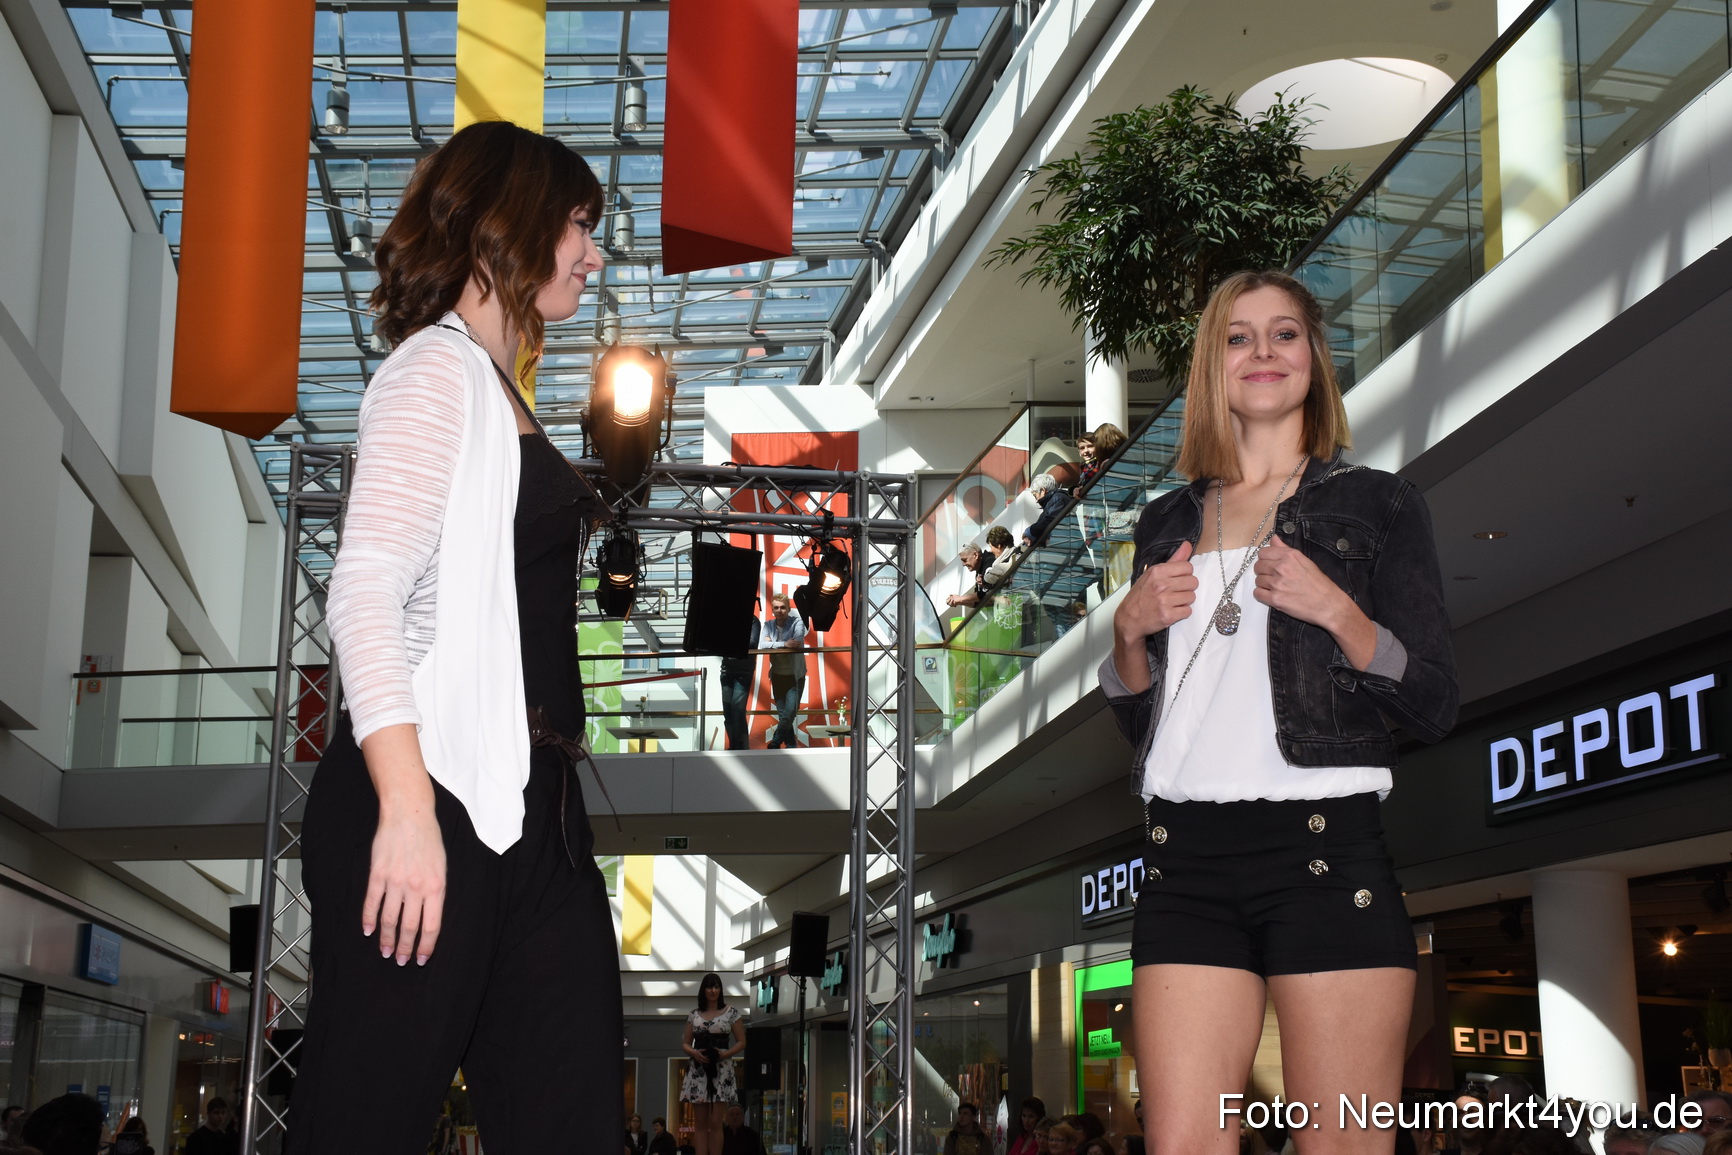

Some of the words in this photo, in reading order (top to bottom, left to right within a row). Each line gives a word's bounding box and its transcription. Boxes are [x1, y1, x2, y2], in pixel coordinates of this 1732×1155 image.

[1490, 673, 1716, 803] DEPOT
[1082, 857, 1146, 916] DEPO
[1453, 1026, 1543, 1056] EPOT
